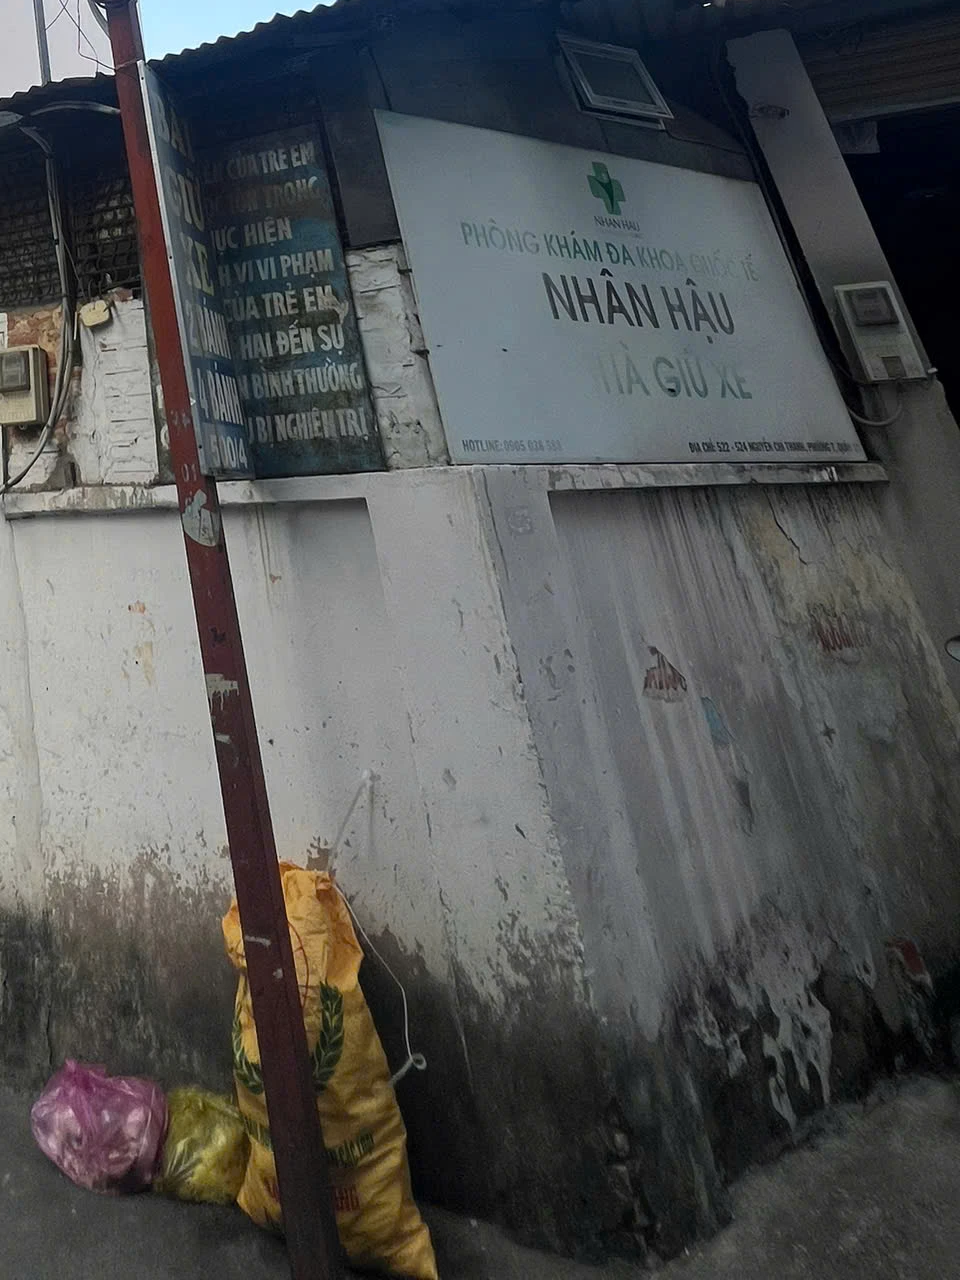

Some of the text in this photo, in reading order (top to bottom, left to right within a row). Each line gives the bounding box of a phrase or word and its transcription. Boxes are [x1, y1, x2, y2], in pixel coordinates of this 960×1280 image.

[290, 141, 315, 168] EM
[244, 216, 293, 247] HIỆN
[180, 232, 215, 297] XE
[255, 256, 277, 280] VI
[280, 249, 334, 279] PHẠM
[543, 229, 604, 263] KHÁM
[605, 242, 636, 267] ĐA
[636, 246, 688, 272] KHOA
[261, 282, 300, 318] TRẺ
[302, 285, 334, 312] EM
[542, 268, 735, 345] NHÂN HẬU
[275, 319, 315, 355] ĐẾN
[197, 367, 210, 419] 4
[207, 361, 244, 426] BÁNH
[252, 365, 295, 400] BÌNH
